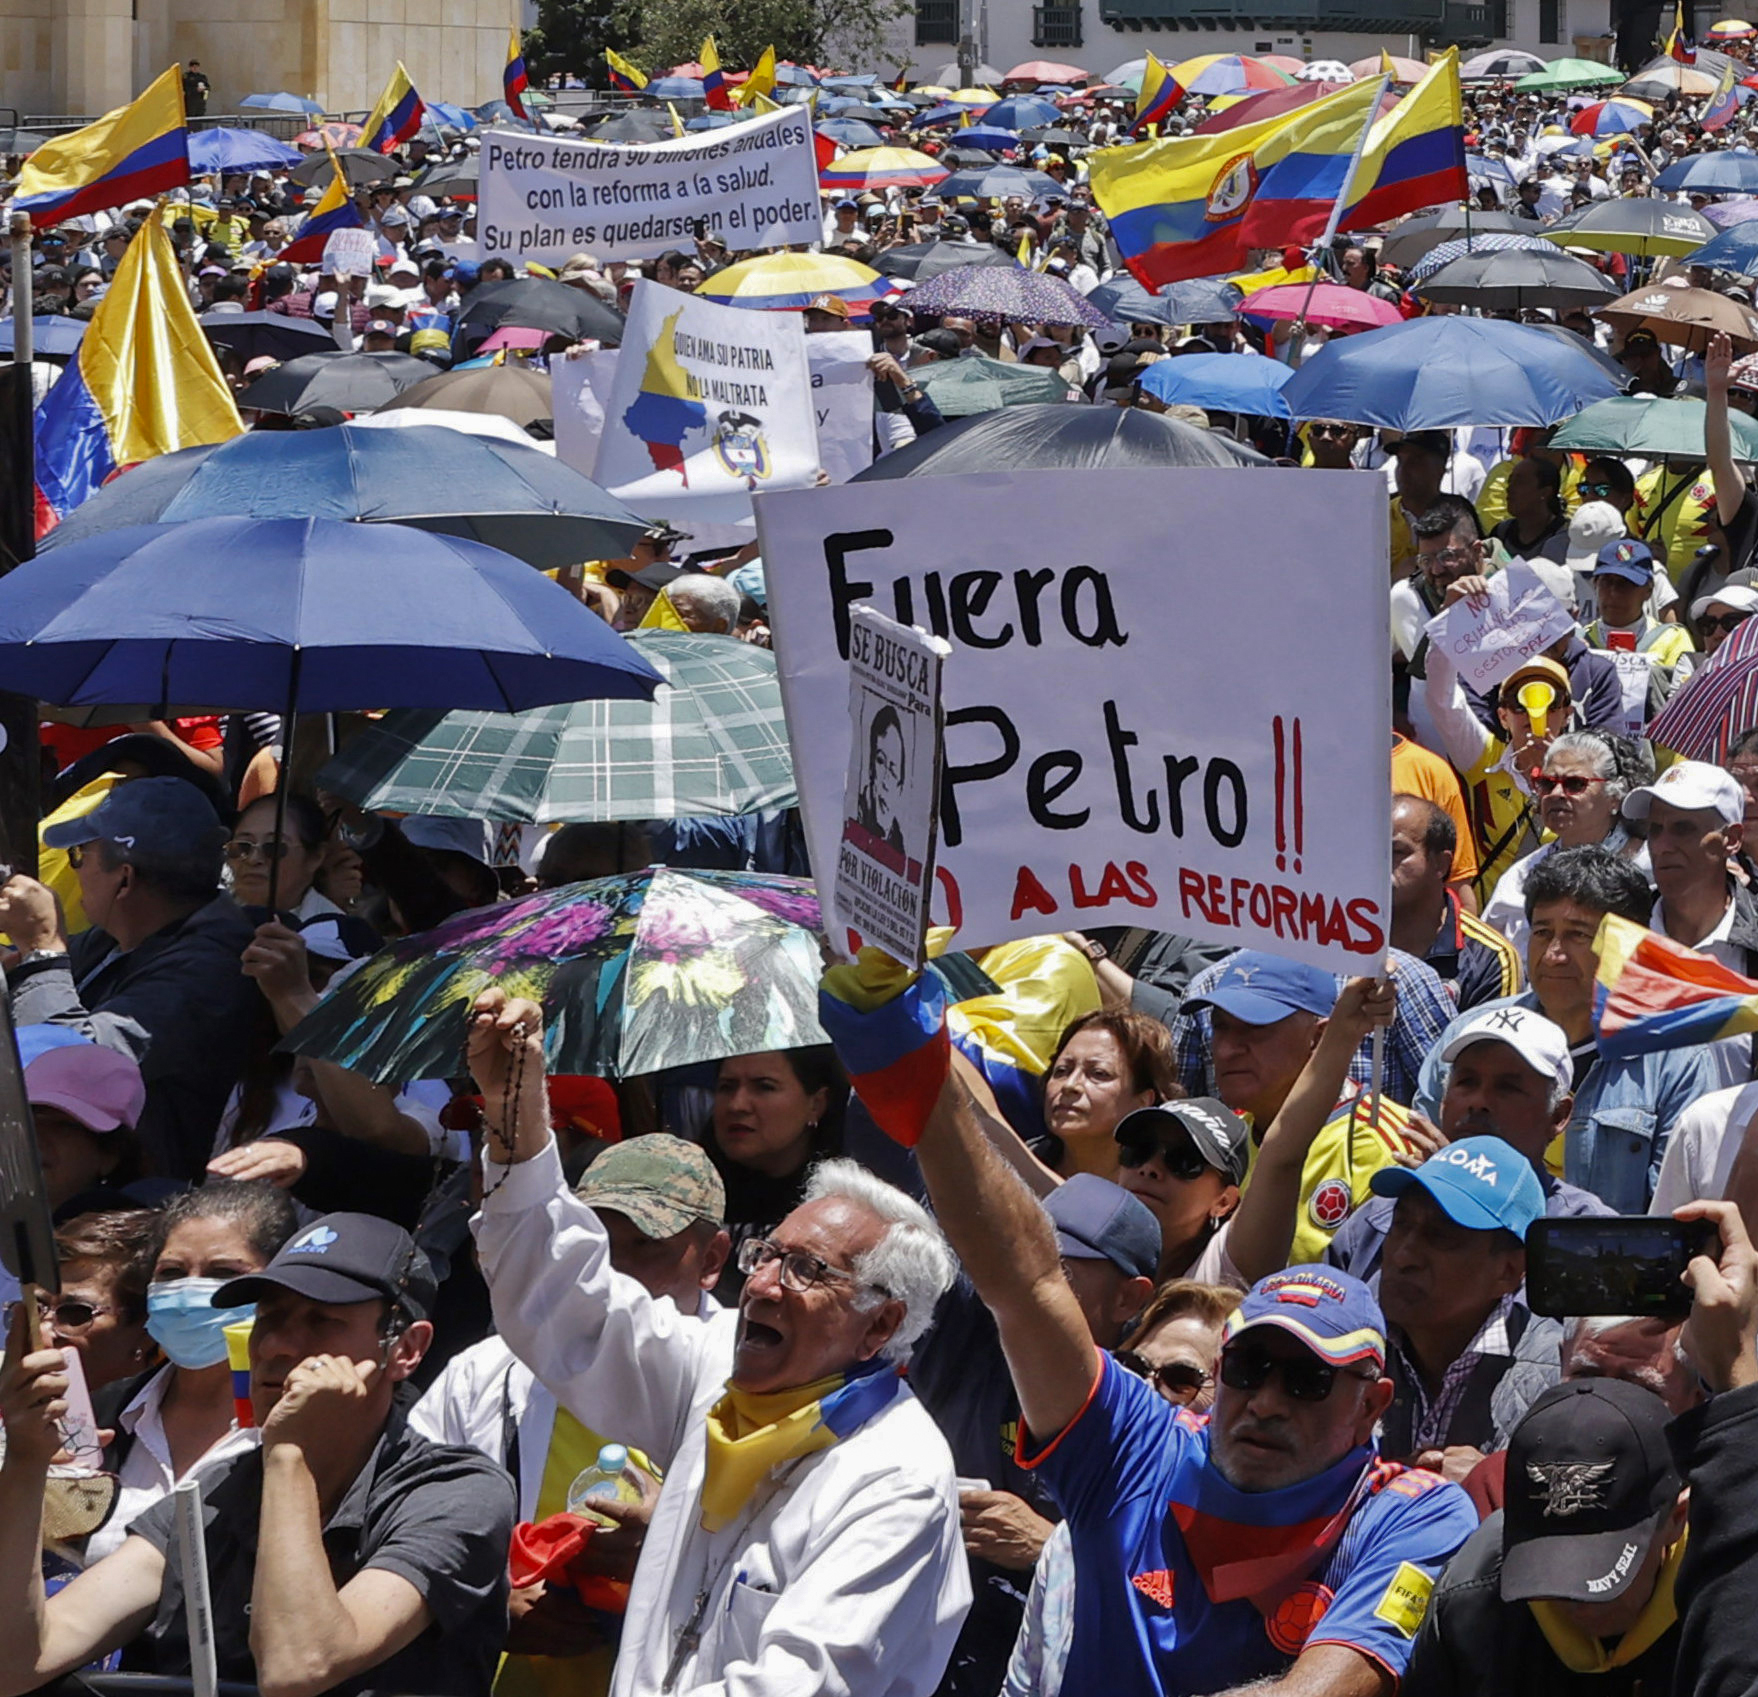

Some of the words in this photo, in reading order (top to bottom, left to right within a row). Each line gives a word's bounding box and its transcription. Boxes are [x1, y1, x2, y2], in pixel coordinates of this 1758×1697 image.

[489, 145, 545, 171] Petro
[733, 123, 805, 154] anuales
[527, 186, 564, 210] con
[569, 181, 587, 207] la
[593, 179, 671, 206] reforma
[677, 180, 689, 198] a
[694, 173, 712, 196] la
[717, 162, 775, 192] salud.
[485, 225, 512, 251] Su
[519, 223, 565, 254] plan
[572, 225, 596, 245] es
[603, 214, 694, 248] quedarse
[702, 211, 723, 232] en
[729, 202, 746, 229] el
[753, 198, 817, 232] poder.
[674, 332, 696, 360] QUIEN
[698, 338, 715, 364] AMA
[717, 343, 729, 367] SU
[731, 347, 774, 370] PATRIA
[686, 372, 698, 397] NO
[700, 376, 710, 399] LA
[711, 379, 769, 406] MALTRATA
[823, 529, 1129, 661] Fuera
[1465, 591, 1491, 619] NO
[852, 623, 871, 664] SE
[873, 634, 929, 697] BUSCA
[907, 692, 931, 717] Para
[839, 847, 858, 880] POR
[1010, 866, 1058, 921] A
[1068, 862, 1158, 909] LAS
[1178, 865, 1385, 956] REFORMAS
[1586, 1570, 1620, 1593] NAVY
[1615, 1543, 1638, 1577] SEAL
